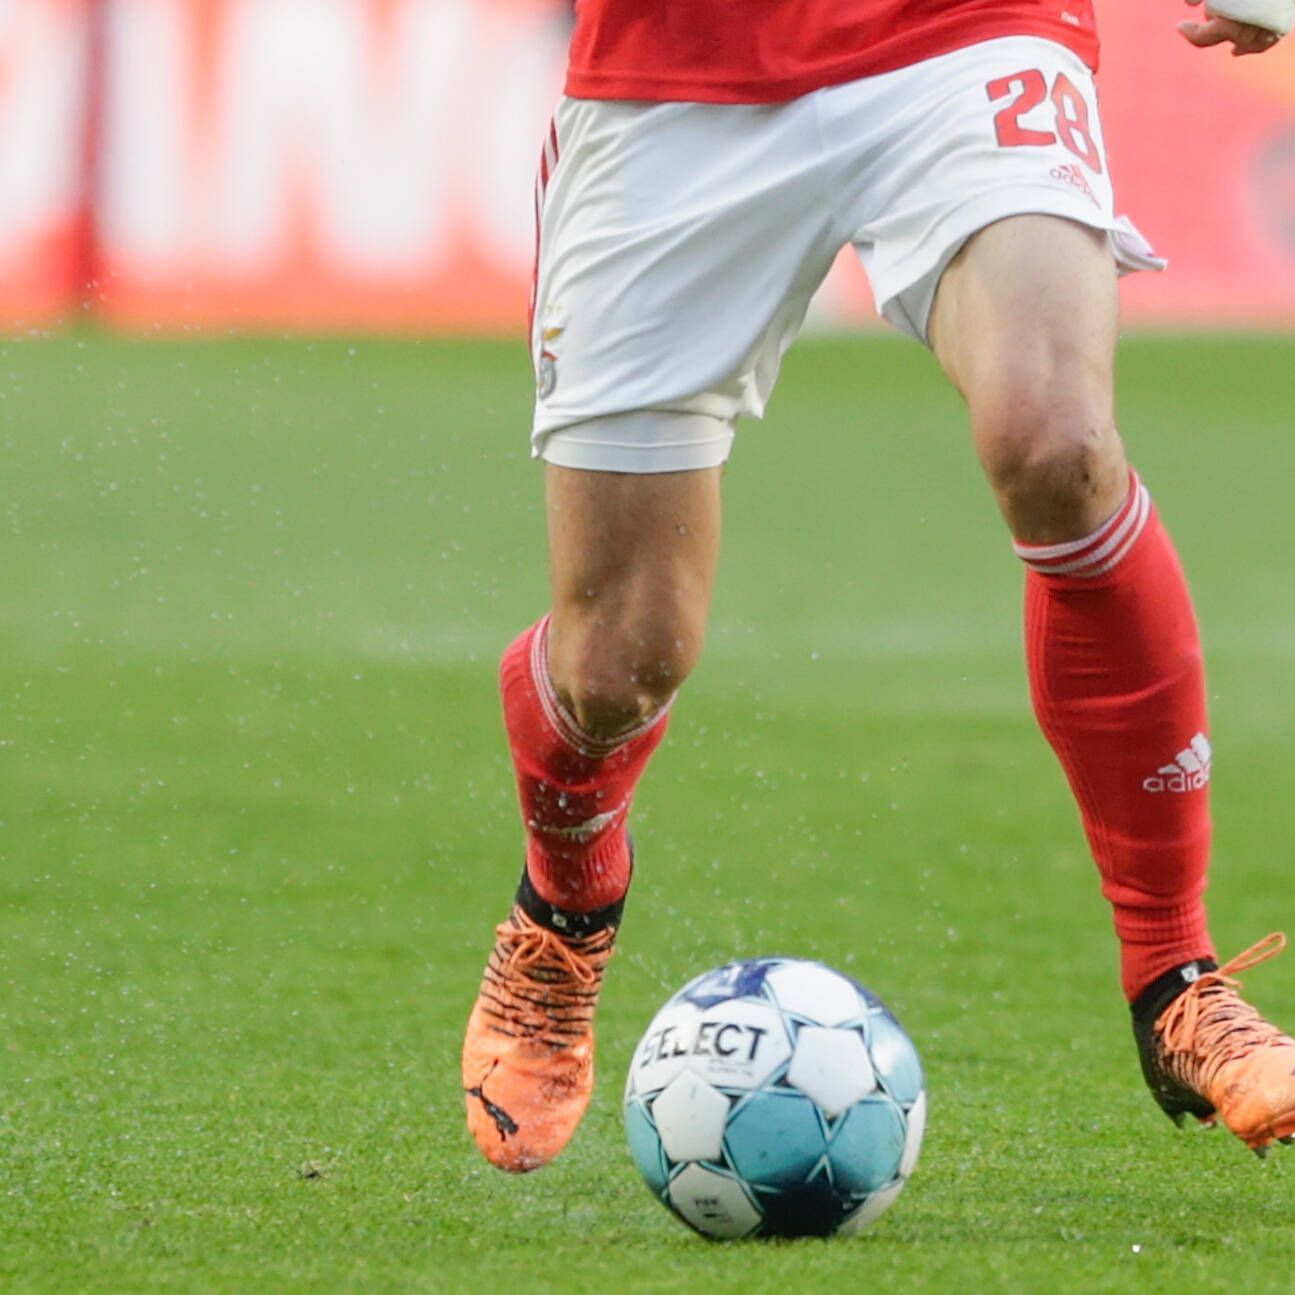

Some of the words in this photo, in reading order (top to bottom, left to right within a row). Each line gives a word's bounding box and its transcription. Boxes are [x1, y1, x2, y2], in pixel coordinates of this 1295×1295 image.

[985, 68, 1102, 175] 28
[1142, 762, 1212, 793] adid
[640, 1021, 768, 1069] SELECT
